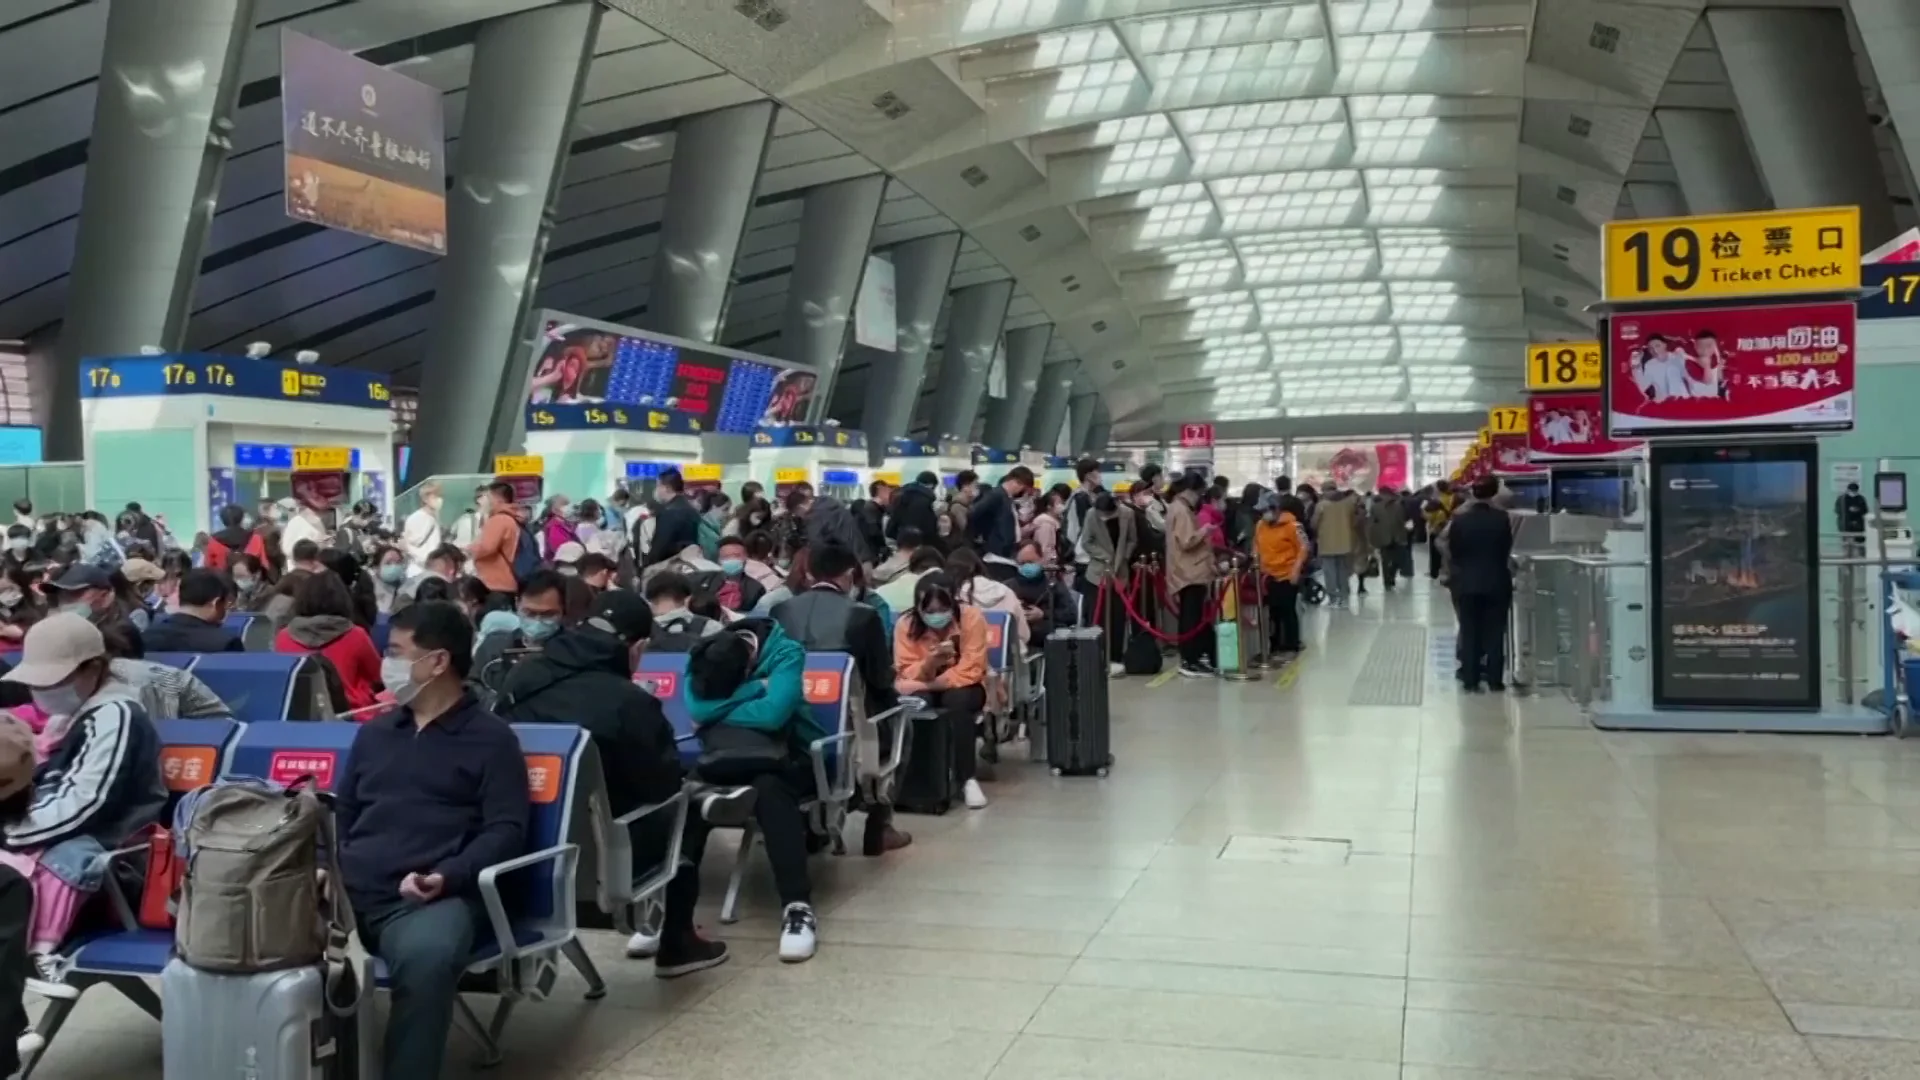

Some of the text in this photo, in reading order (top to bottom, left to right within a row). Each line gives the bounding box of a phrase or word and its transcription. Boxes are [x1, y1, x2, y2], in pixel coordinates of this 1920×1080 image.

[1624, 226, 1844, 292] 19 检票口
[1711, 262, 1843, 283] Ticket Check
[1882, 274, 1920, 304] 17
[1535, 349, 1577, 383] 18
[1493, 410, 1519, 430] 17
[296, 451, 313, 466] 17
